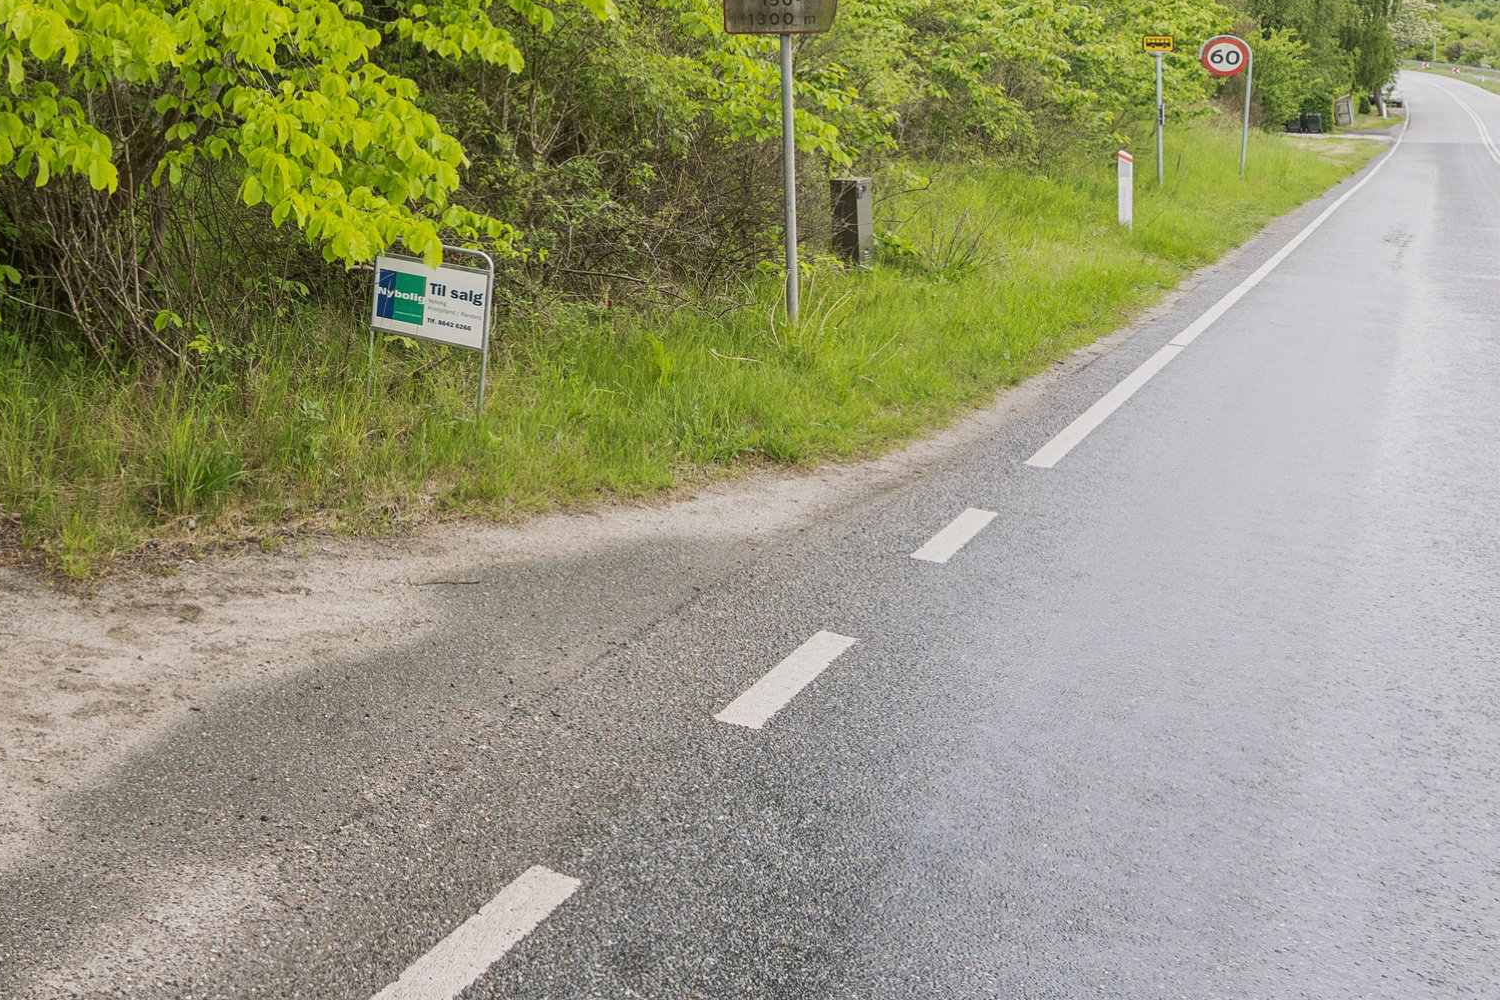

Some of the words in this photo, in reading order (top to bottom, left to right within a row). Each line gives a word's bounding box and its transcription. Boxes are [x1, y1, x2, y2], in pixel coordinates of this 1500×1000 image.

[749, 12, 794, 26] 1300
[804, 15, 816, 25] m
[1210, 49, 1240, 65] 60
[378, 287, 425, 305] Nybolig
[430, 283, 446, 297] Til
[450, 290, 483, 306] salg
